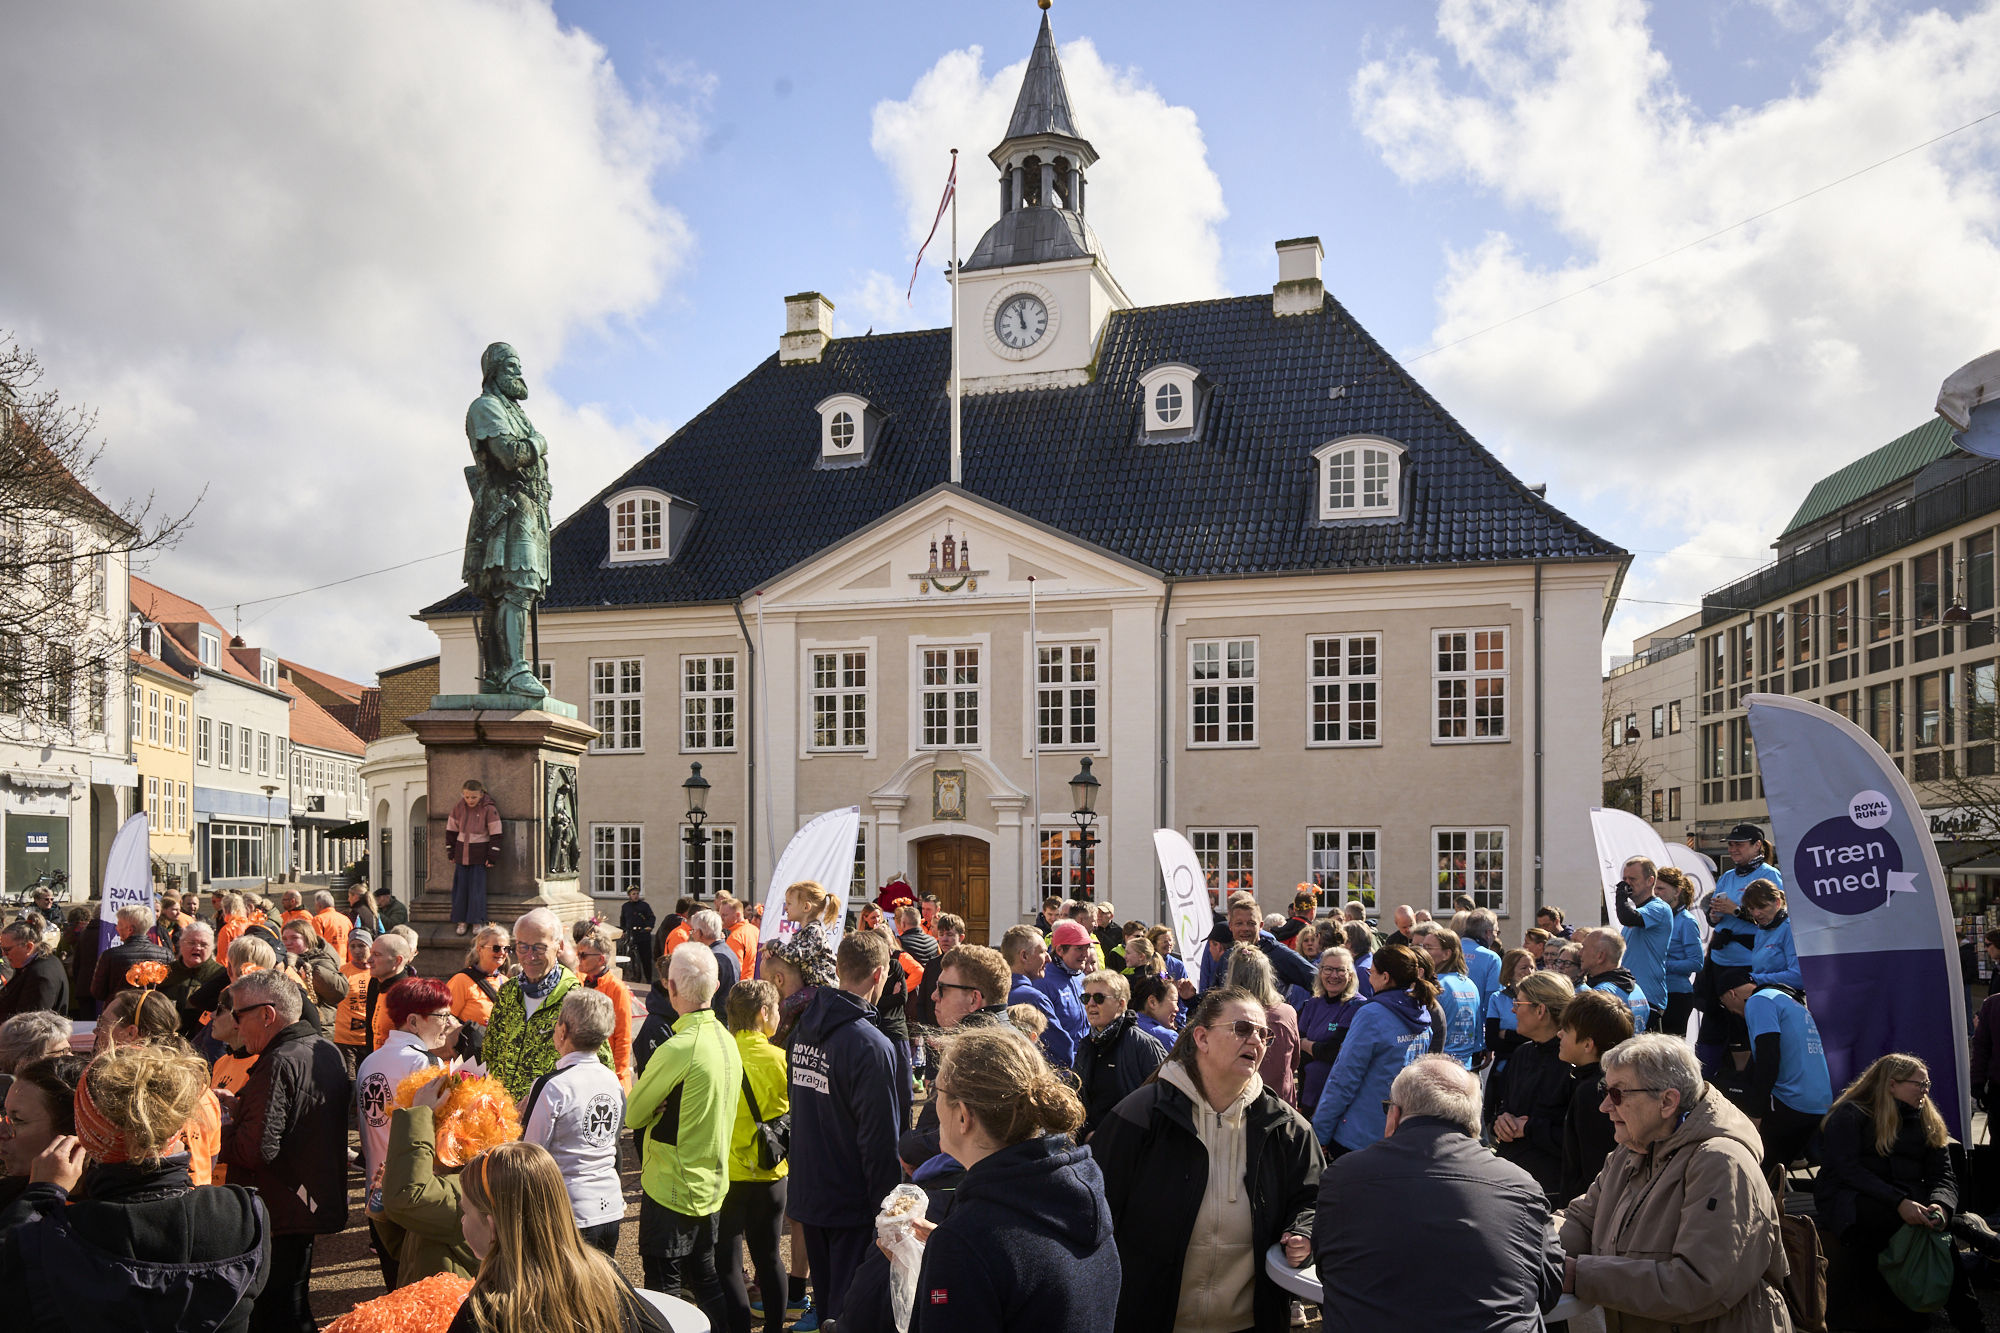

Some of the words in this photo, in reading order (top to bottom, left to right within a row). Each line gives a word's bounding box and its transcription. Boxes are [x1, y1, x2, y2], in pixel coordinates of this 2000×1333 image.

[1854, 801, 1887, 812] ROYAL
[1856, 810, 1877, 819] RUN
[1806, 841, 1885, 868] Træn
[1813, 865, 1881, 897] med
[793, 1043, 820, 1058] ROYAL
[792, 1054, 809, 1066] RUN
